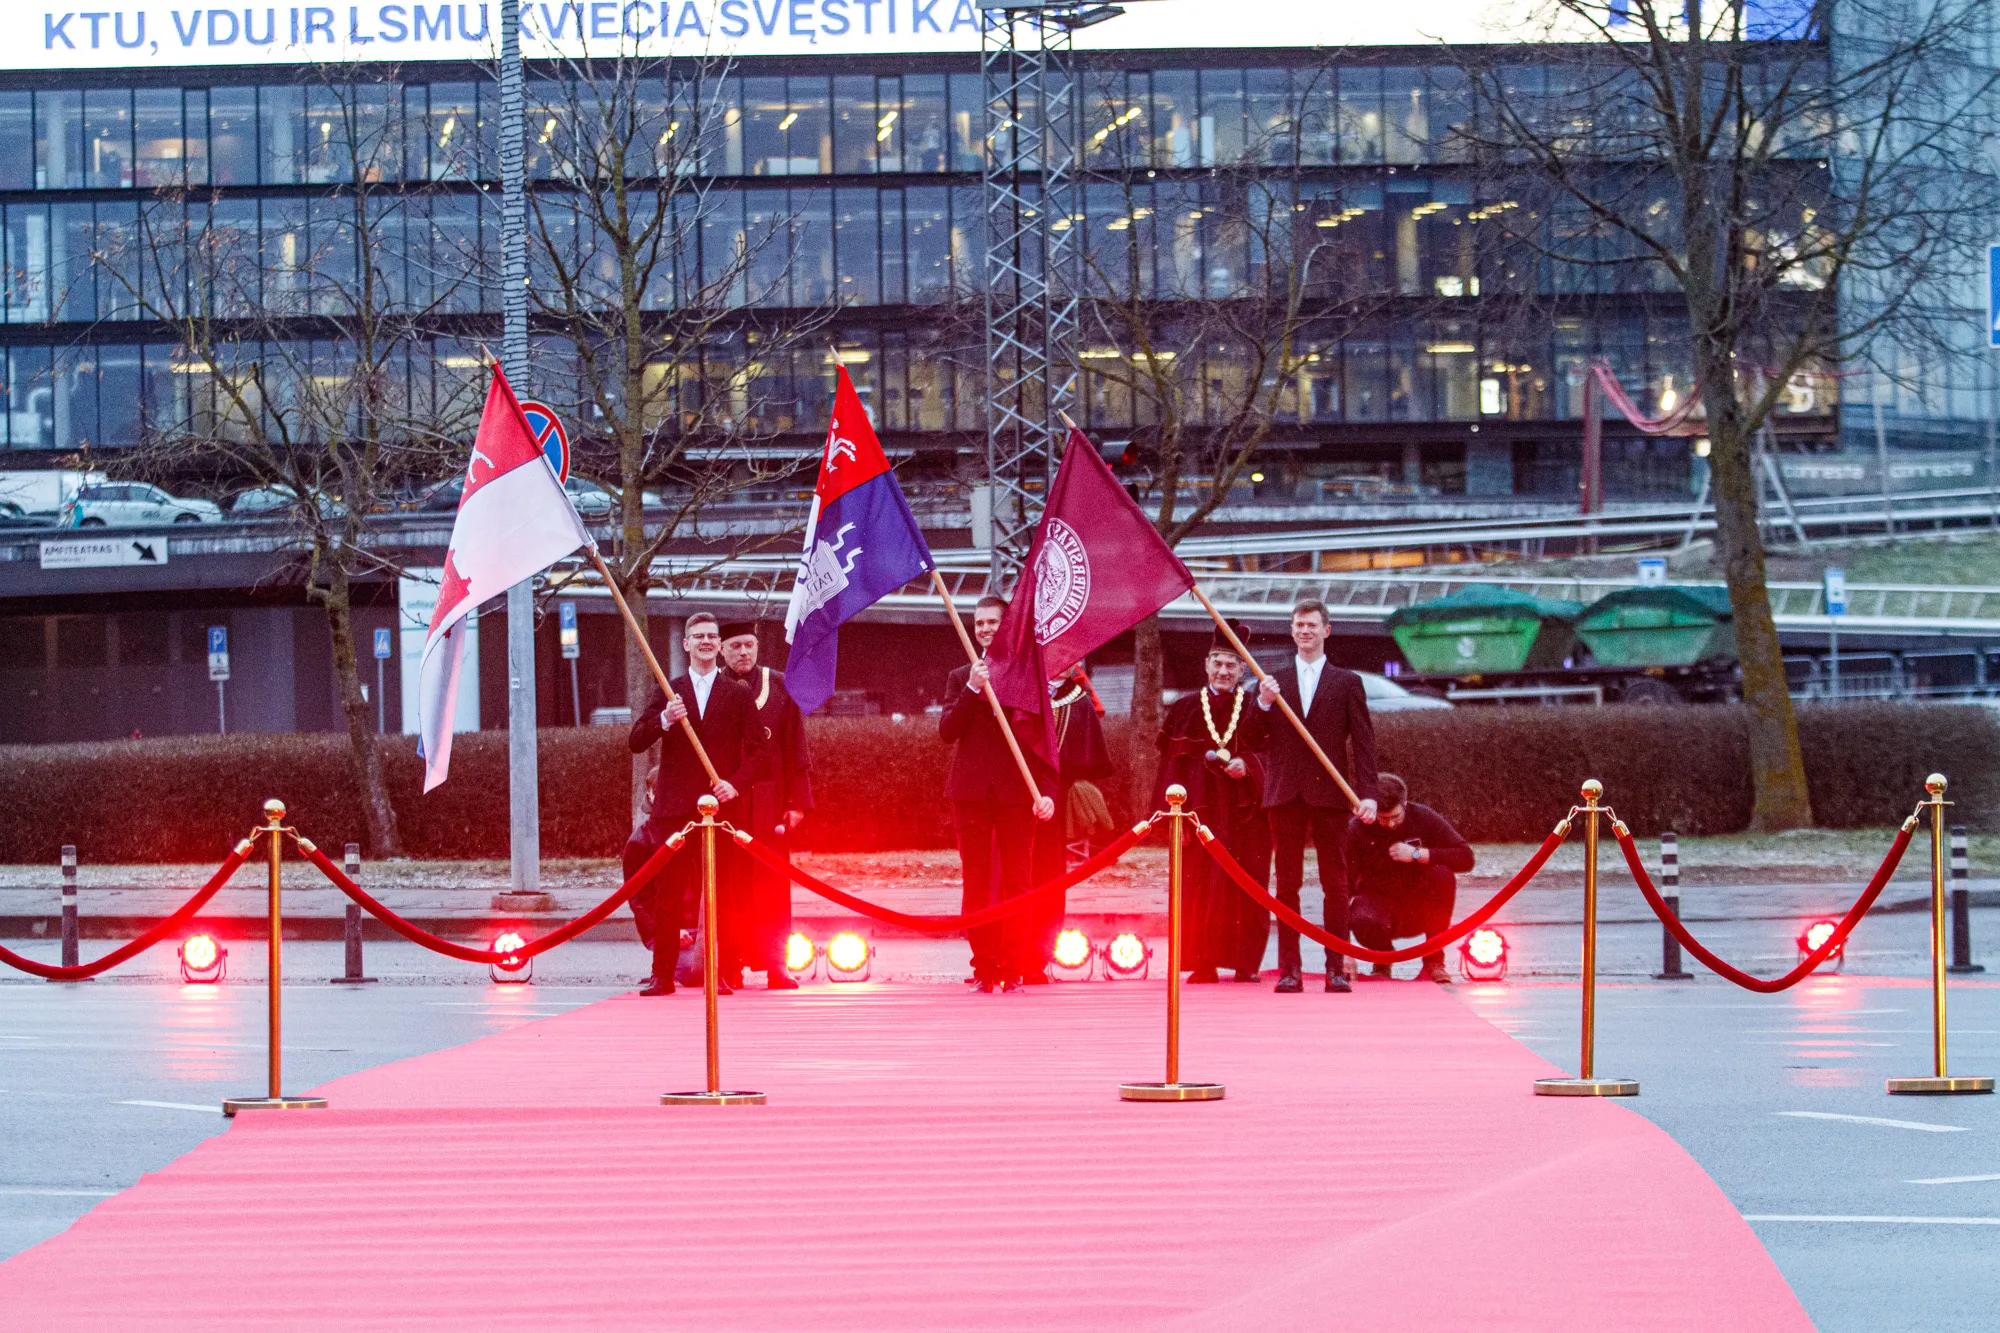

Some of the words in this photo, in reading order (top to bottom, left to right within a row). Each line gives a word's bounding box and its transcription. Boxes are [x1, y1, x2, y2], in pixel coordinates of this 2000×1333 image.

[44, 12, 159, 55] KTU,
[170, 8, 275, 48] VDU
[289, 7, 335, 45] IR
[349, 4, 489, 43] LSMU
[44, 544, 113, 556] AMFITEATRAS
[213, 630, 224, 652] P
